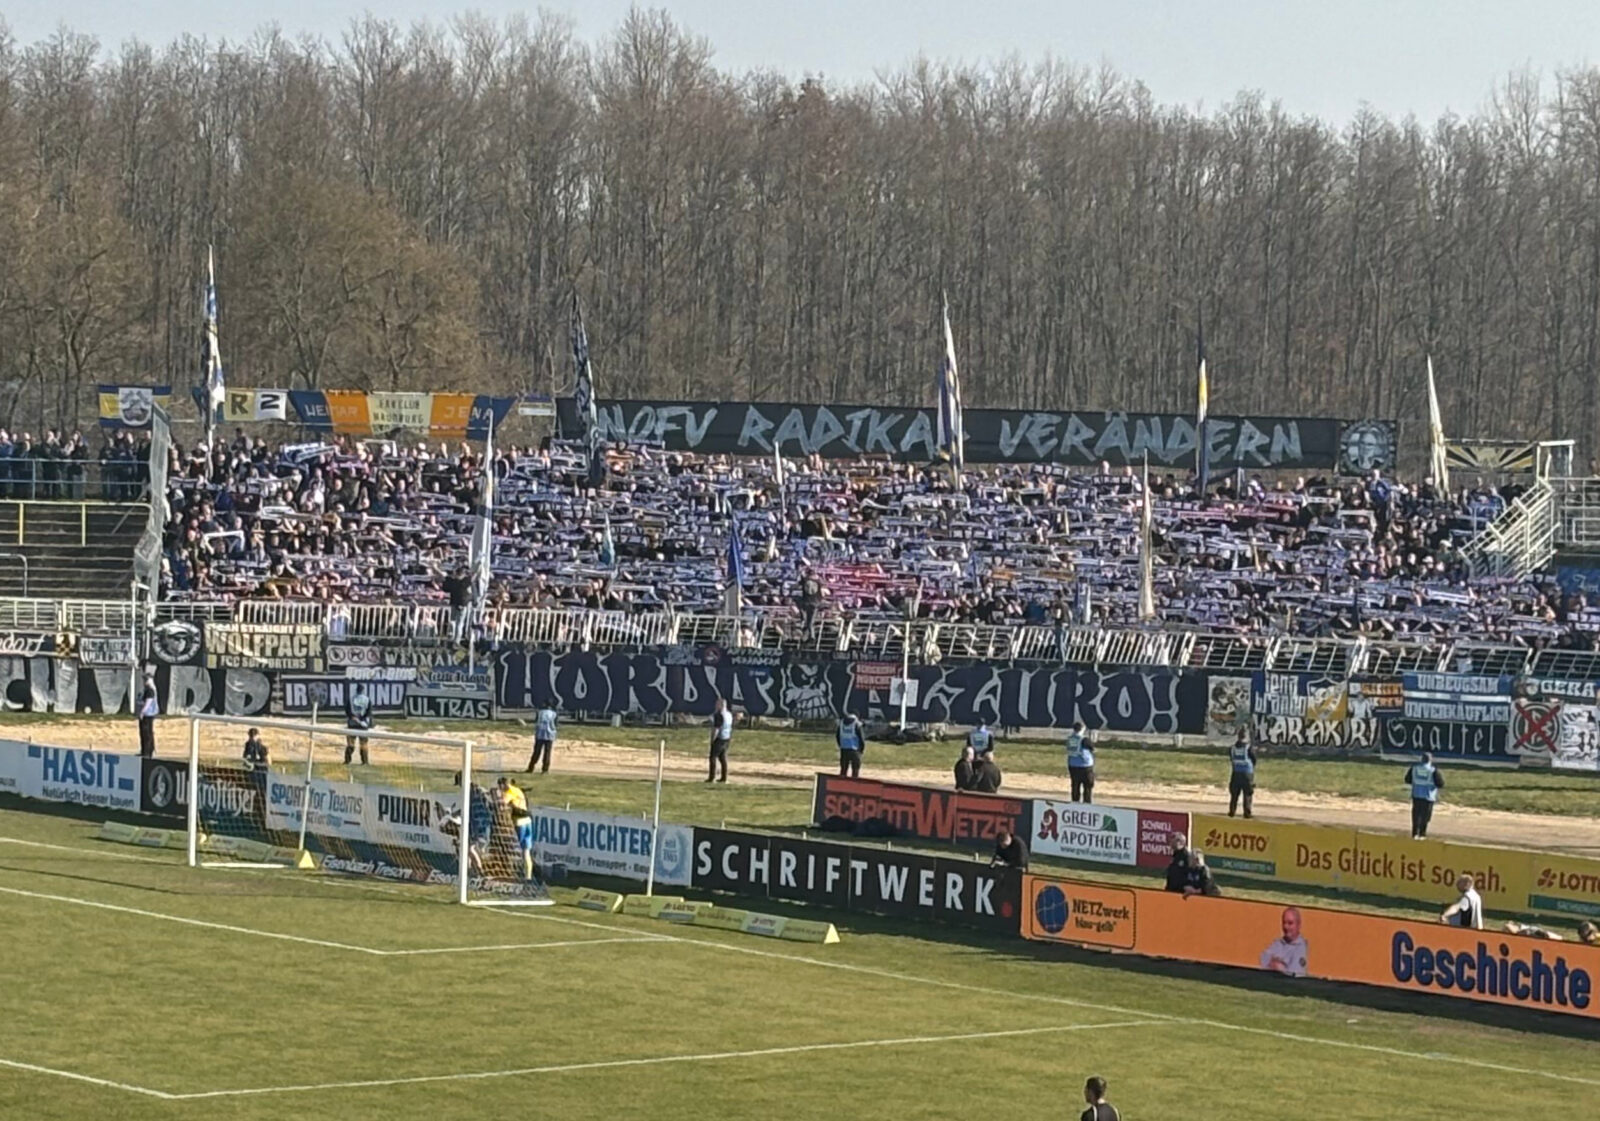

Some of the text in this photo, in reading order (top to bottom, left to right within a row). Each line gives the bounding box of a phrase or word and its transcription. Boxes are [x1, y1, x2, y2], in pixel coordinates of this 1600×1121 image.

[444, 406, 494, 421] JENA
[599, 404, 1303, 467] NOFV RADIKA VERÄNDERN
[204, 631, 323, 658] WOLFPACK
[220, 655, 240, 668] FCC
[500, 651, 776, 716] HORDA
[1418, 674, 1500, 694] UNBEUGSAM
[1541, 679, 1596, 698] GERA
[409, 696, 490, 720] ULTRAS
[1386, 715, 1495, 755] Saalfel
[42, 746, 120, 790] HASIT
[329, 788, 363, 815] Teams
[378, 793, 431, 828] PUMA
[1062, 809, 1100, 827] GREIF
[577, 822, 652, 857] RICHTER
[1060, 830, 1131, 850] APOTHEKE
[1223, 831, 1267, 853] LOTTO
[323, 854, 375, 875] Eisenbach
[1296, 843, 1333, 870] Das
[1338, 847, 1394, 880] Glück
[1400, 854, 1426, 883] ist
[1431, 864, 1454, 885] so
[1559, 871, 1600, 894] LOTT
[1072, 898, 1130, 920] NETZwerk
[1392, 930, 1592, 1010] Geschichte
